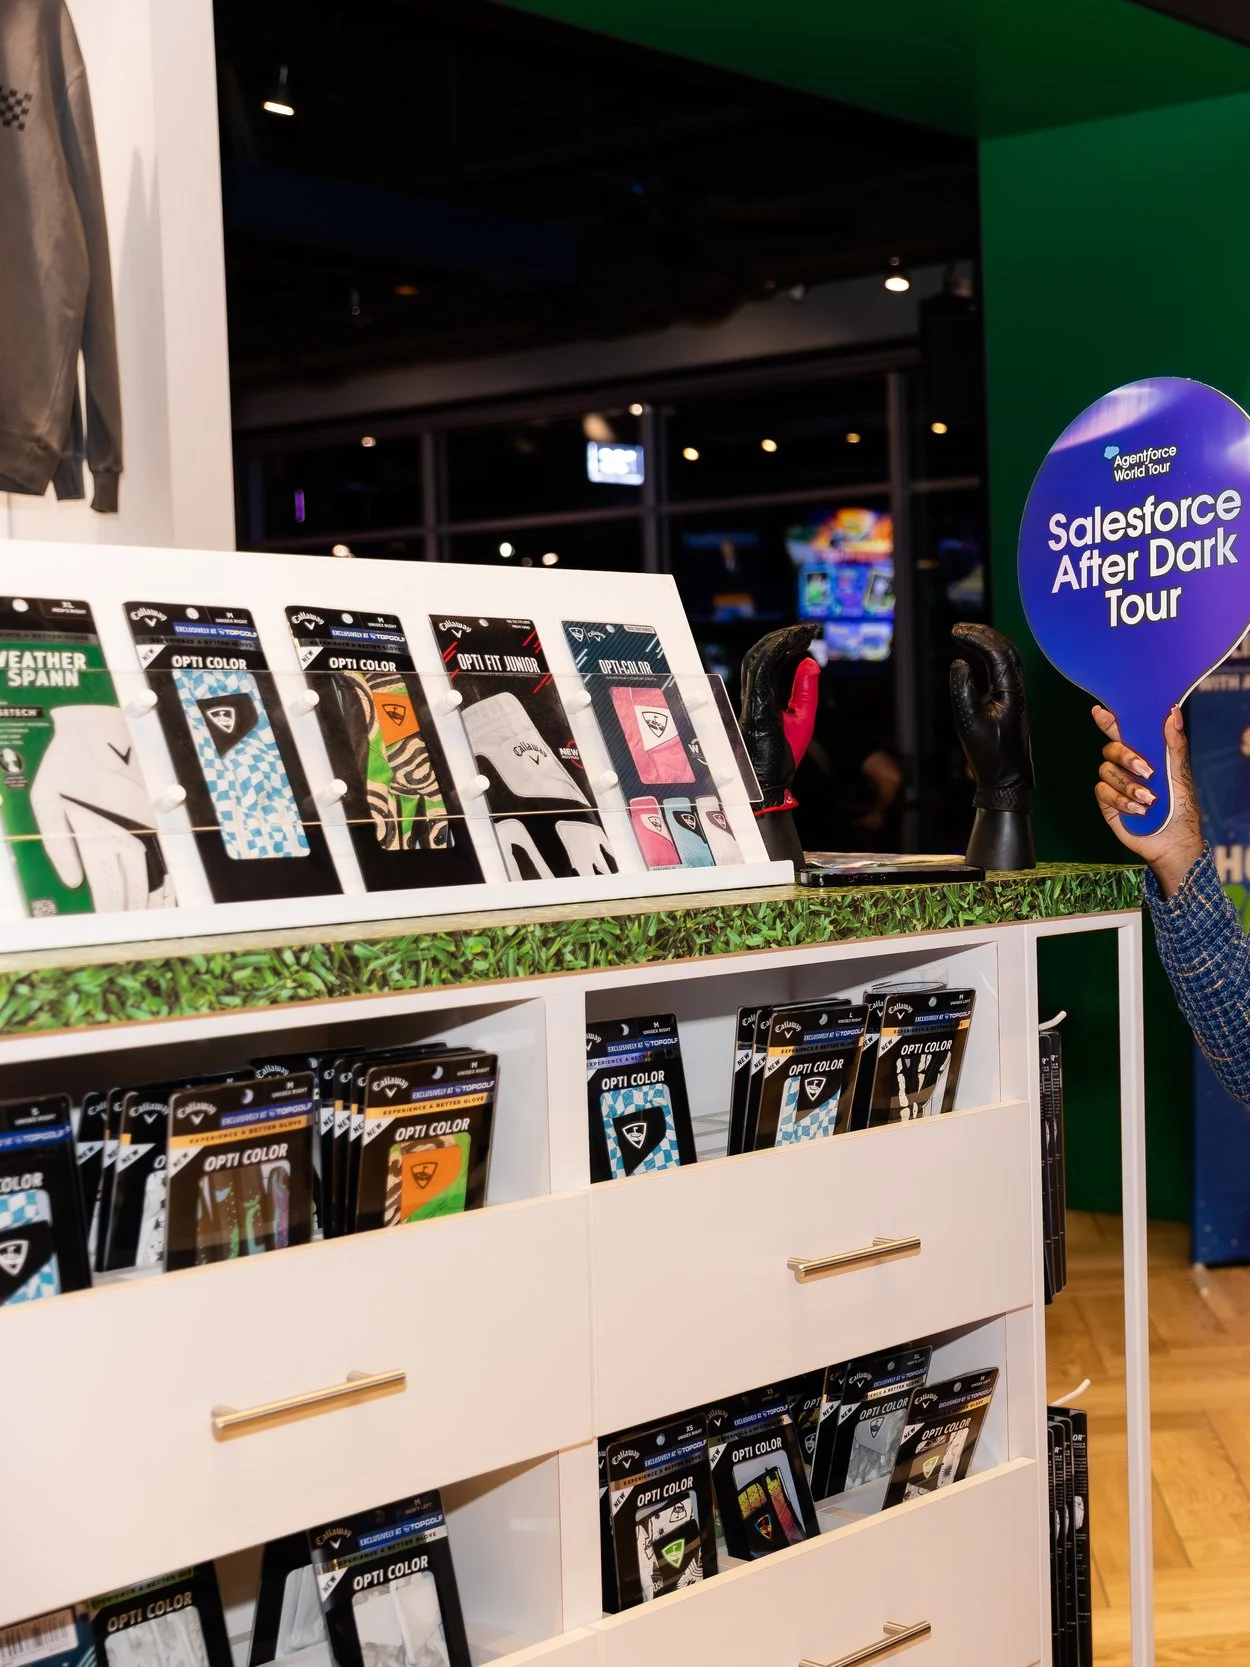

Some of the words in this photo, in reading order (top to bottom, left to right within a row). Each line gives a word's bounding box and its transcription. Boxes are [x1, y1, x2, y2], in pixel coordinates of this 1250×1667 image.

[1114, 446, 1177, 468] Agentforce
[1114, 465, 1146, 482] World
[1148, 461, 1171, 476] Tour
[1048, 489, 1241, 552] Salesforce
[1052, 548, 1139, 594] After
[1150, 527, 1239, 578] Dark
[130, 607, 167, 622] Callaway
[1105, 586, 1182, 627] Tour
[291, 611, 325, 625] Callaway
[175, 625, 210, 635] EXCLUSIVELY
[225, 629, 258, 638] TOPGOLF
[439, 620, 472, 633] Callaway
[331, 629, 363, 639] EXCLUSIVELY
[376, 634, 406, 642] TOPGOLF
[142, 648, 154, 661] NEW
[171, 655, 204, 668] OPTI
[206, 657, 248, 670] COLOR
[301, 650, 314, 663] NEW
[329, 657, 357, 669] OPTI
[359, 659, 397, 672] COLOR
[457, 653, 485, 670] OPTI
[484, 654, 503, 671] FIT
[503, 655, 541, 673] JUNIOR
[598, 659, 654, 675] OPTI-COLOR
[7, 668, 80, 688] SPANN
[0, 708, 37, 717] SETECH
[513, 741, 548, 758] Callaway
[559, 747, 579, 756] NEW
[868, 1000, 884, 1012] Calla
[888, 1002, 914, 1014] Callaway
[914, 1014, 939, 1023] EXCLUSIVELY
[949, 1010, 972, 1019] TOPGOLF
[775, 1021, 802, 1033] Callaway
[803, 1032, 829, 1041] EXCLUSIVELY
[840, 1027, 865, 1037] TOPGOLF
[607, 1042, 638, 1053] EXCLUSIVELY
[637, 1041, 644, 1049] AT
[650, 1037, 679, 1047] TOPGOLF
[881, 1038, 893, 1052] NEW
[900, 1044, 923, 1056] OPTI
[924, 1039, 953, 1053] COLOR
[471, 1061, 478, 1069] M
[737, 1052, 750, 1066] NEW
[754, 1055, 766, 1069] NEW
[767, 1058, 780, 1073] NEW
[788, 1062, 811, 1076] OPTI
[813, 1058, 845, 1072] COLOR
[256, 1065, 290, 1080] Callaway
[457, 1069, 475, 1077] UNISEX
[475, 1067, 490, 1075] RIGHT
[601, 1075, 628, 1090] OPTI
[630, 1070, 666, 1086] COLOR
[372, 1076, 409, 1092] Callaway
[412, 1088, 446, 1100] EXCLUSIVELY
[446, 1086, 454, 1095] AT
[462, 1080, 496, 1092] TOPGOLF
[128, 1102, 170, 1117] Callaway
[176, 1102, 217, 1119] Callaway
[383, 1104, 426, 1116] EXPERIENCE
[435, 1099, 461, 1108] BETTER
[463, 1095, 485, 1104] GLOVE
[221, 1113, 259, 1127] EXCLUSIVELY
[259, 1111, 267, 1119] AT
[276, 1102, 313, 1116] TOPGOLF
[366, 1122, 383, 1138] NEW
[395, 1125, 427, 1142] OPTI
[429, 1117, 471, 1137] COLOR
[121, 1149, 139, 1165] NEW
[172, 1152, 189, 1168] NEW
[204, 1152, 240, 1172] OPTI
[242, 1143, 289, 1165] COLOR
[848, 1372, 872, 1384] Callaway
[905, 1366, 927, 1377] TOPGOLF
[914, 1393, 938, 1405] Callaway
[971, 1387, 993, 1399] TOPGOLF
[804, 1397, 821, 1410] OPT
[822, 1403, 835, 1417] NEW
[860, 1405, 880, 1420] OPTI
[881, 1397, 909, 1414] COLOR
[733, 1414, 757, 1426] EXCLUSIVELY
[767, 1404, 789, 1416] TOPGOLF
[841, 1406, 853, 1420] NEW
[686, 1424, 694, 1433] XS
[904, 1426, 916, 1440] NEW
[921, 1425, 942, 1440] OPTI
[943, 1417, 972, 1434] COLOR
[612, 1449, 640, 1465] Callaway
[644, 1453, 671, 1467] EXCLUSIVELY
[671, 1450, 677, 1458] AT
[682, 1439, 707, 1453] TOPGOLF
[710, 1447, 721, 1464] NEW
[732, 1445, 753, 1463] OPTI
[755, 1437, 782, 1456] COLOR
[623, 1471, 658, 1486] EXPERIENCE
[613, 1491, 626, 1508] NEW
[637, 1487, 661, 1507] OPTI
[663, 1476, 694, 1498] COLOR
[315, 1527, 352, 1545] Callaway
[360, 1529, 395, 1547] EXCLUSIVELY
[395, 1527, 402, 1535] AT
[410, 1514, 443, 1531] TOPGOLF
[415, 1531, 437, 1542] GLOVE
[353, 1568, 384, 1591] OPTI
[387, 1555, 429, 1579] COLOR
[322, 1574, 337, 1593] NEW
[107, 1610, 142, 1633] OPTI
[146, 1591, 193, 1618] COLOR
